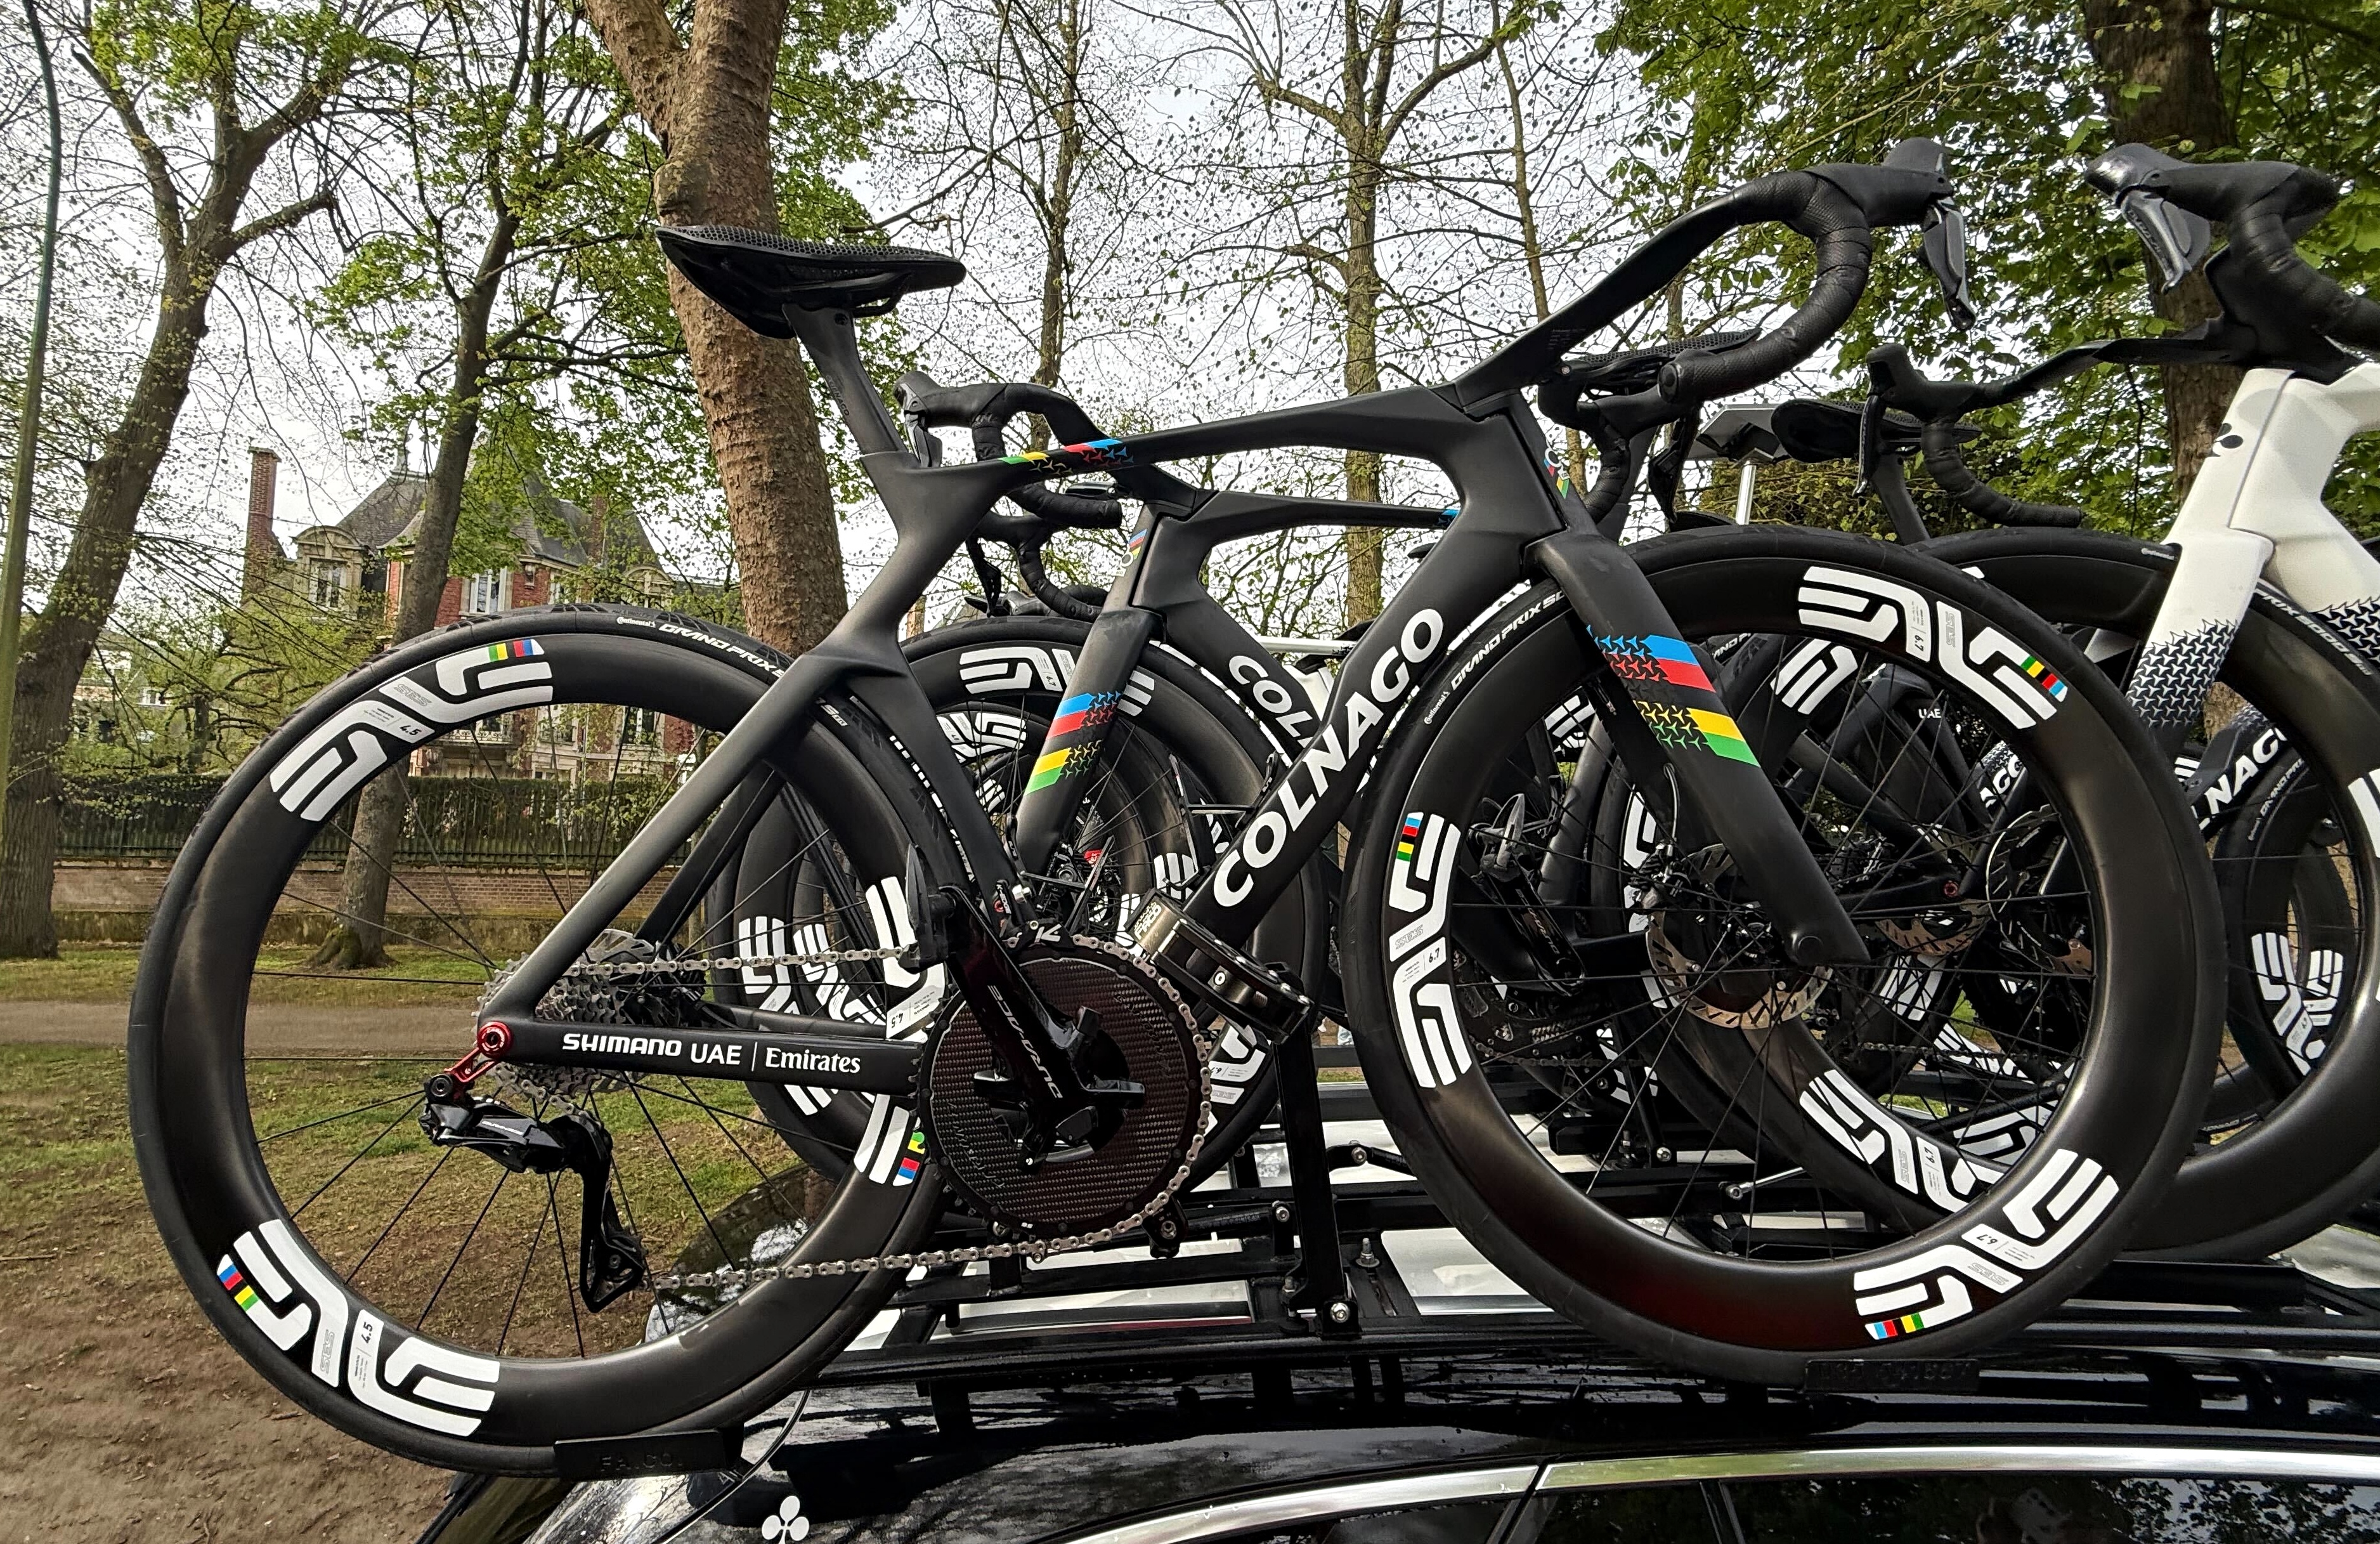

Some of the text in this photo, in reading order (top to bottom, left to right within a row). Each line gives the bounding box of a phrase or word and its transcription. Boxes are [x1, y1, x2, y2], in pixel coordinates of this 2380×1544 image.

[616, 616, 651, 627] Continental
[658, 623, 730, 650] GRAND
[727, 645, 778, 672] PRIX
[1913, 634, 1924, 652] 6.7
[1424, 694, 1447, 724] Continental
[1450, 638, 1501, 691] GRAND
[1501, 602, 1542, 640] PRIX
[1918, 708, 1942, 719] UAE
[399, 724, 422, 736] 4.5
[1213, 608, 1444, 908] COLNAGO
[1428, 946, 1440, 964] 6.7
[891, 1012, 904, 1028] 4.5
[987, 985, 1063, 1099] DURA-ACE
[562, 1033, 861, 1074] SHIMANO UAE Emirates
[1923, 1146, 1936, 1165] 6.7
[1976, 1233, 1999, 1246] 6.7
[362, 1321, 374, 1344] 4.5
